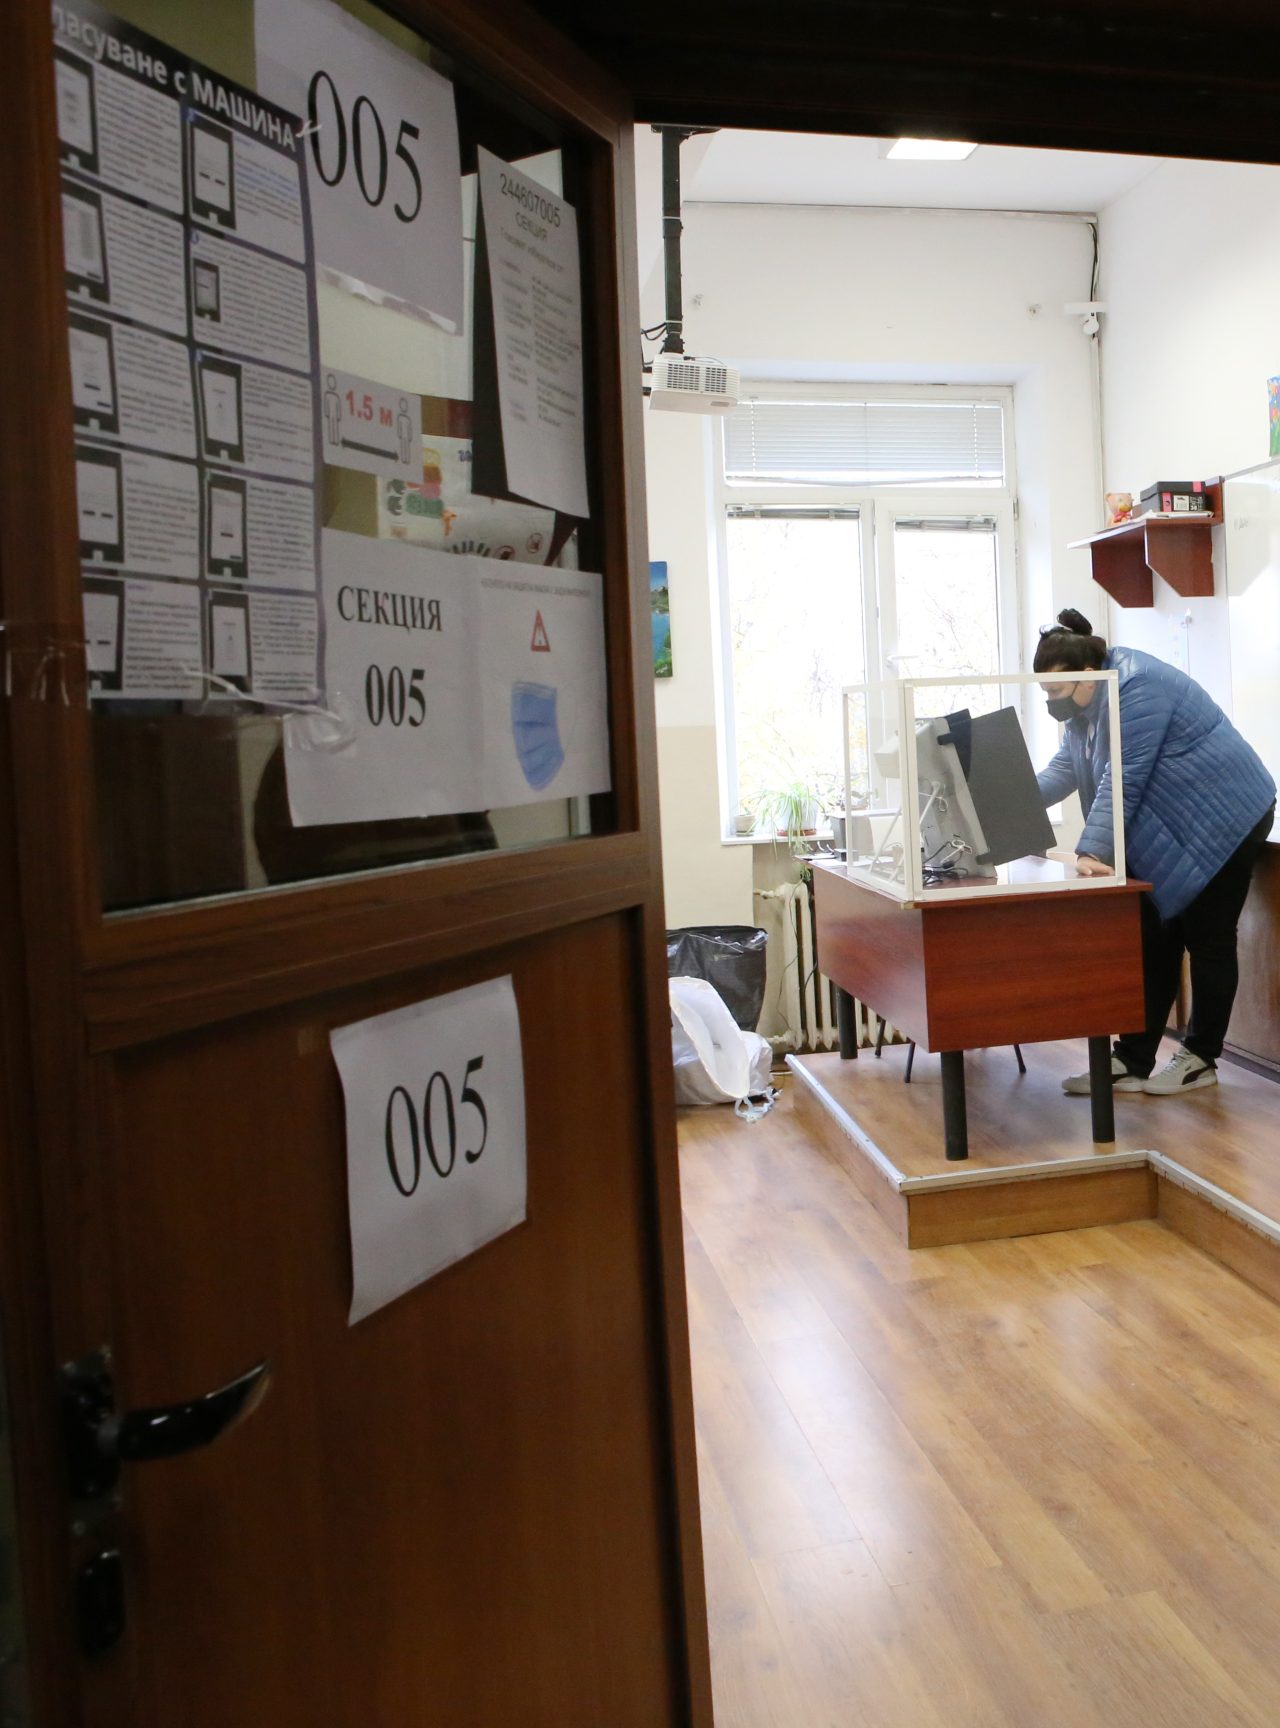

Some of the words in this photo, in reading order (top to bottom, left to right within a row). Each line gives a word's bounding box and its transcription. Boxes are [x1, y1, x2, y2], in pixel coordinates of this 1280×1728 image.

[52, 4, 168, 86] ласуване
[173, 70, 187, 95] с
[191, 70, 297, 153] МАШИНА
[307, 69, 423, 224] 005
[345, 390, 374, 421] 1.5
[337, 584, 443, 633] СЕКЦИЯ
[365, 663, 427, 727] 005
[384, 1054, 488, 1198] 005
